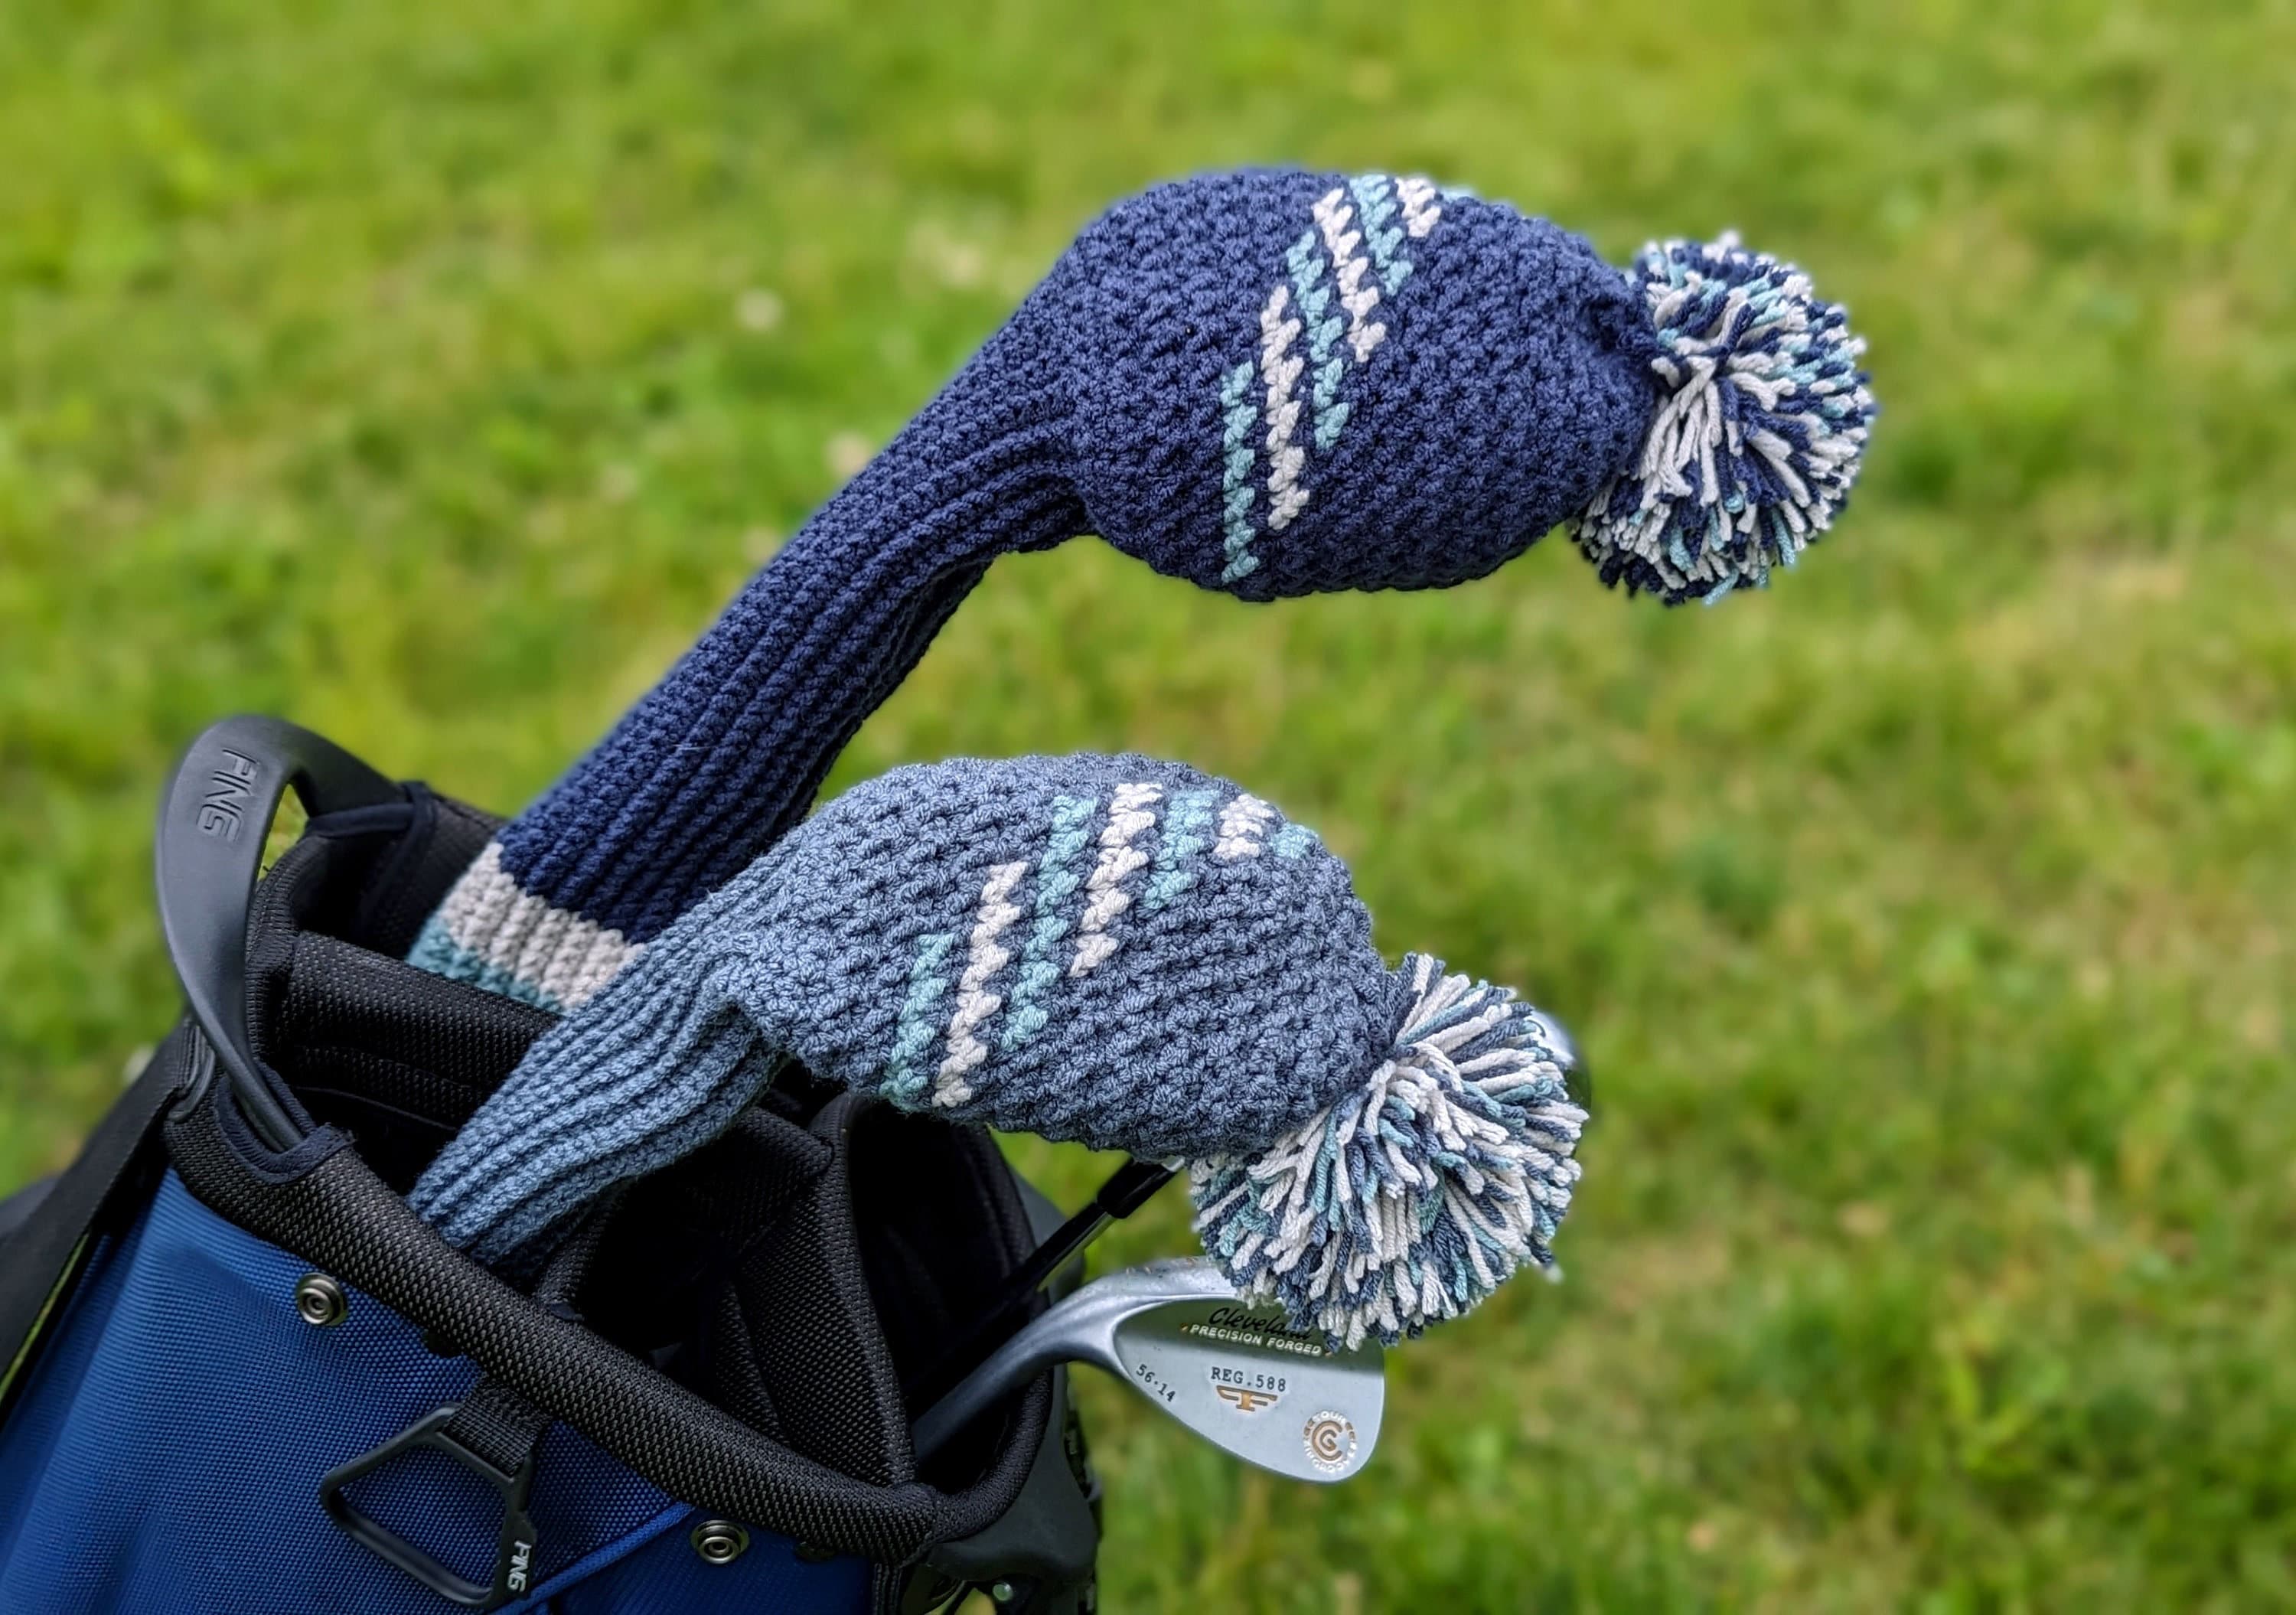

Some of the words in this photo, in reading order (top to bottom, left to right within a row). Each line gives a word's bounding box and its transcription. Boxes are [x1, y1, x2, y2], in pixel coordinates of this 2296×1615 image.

[197, 747, 259, 843] PING
[1189, 1324, 1262, 1346] PRECISION
[1267, 1337, 1322, 1356] FORGED
[507, 1540, 532, 1592] PING
